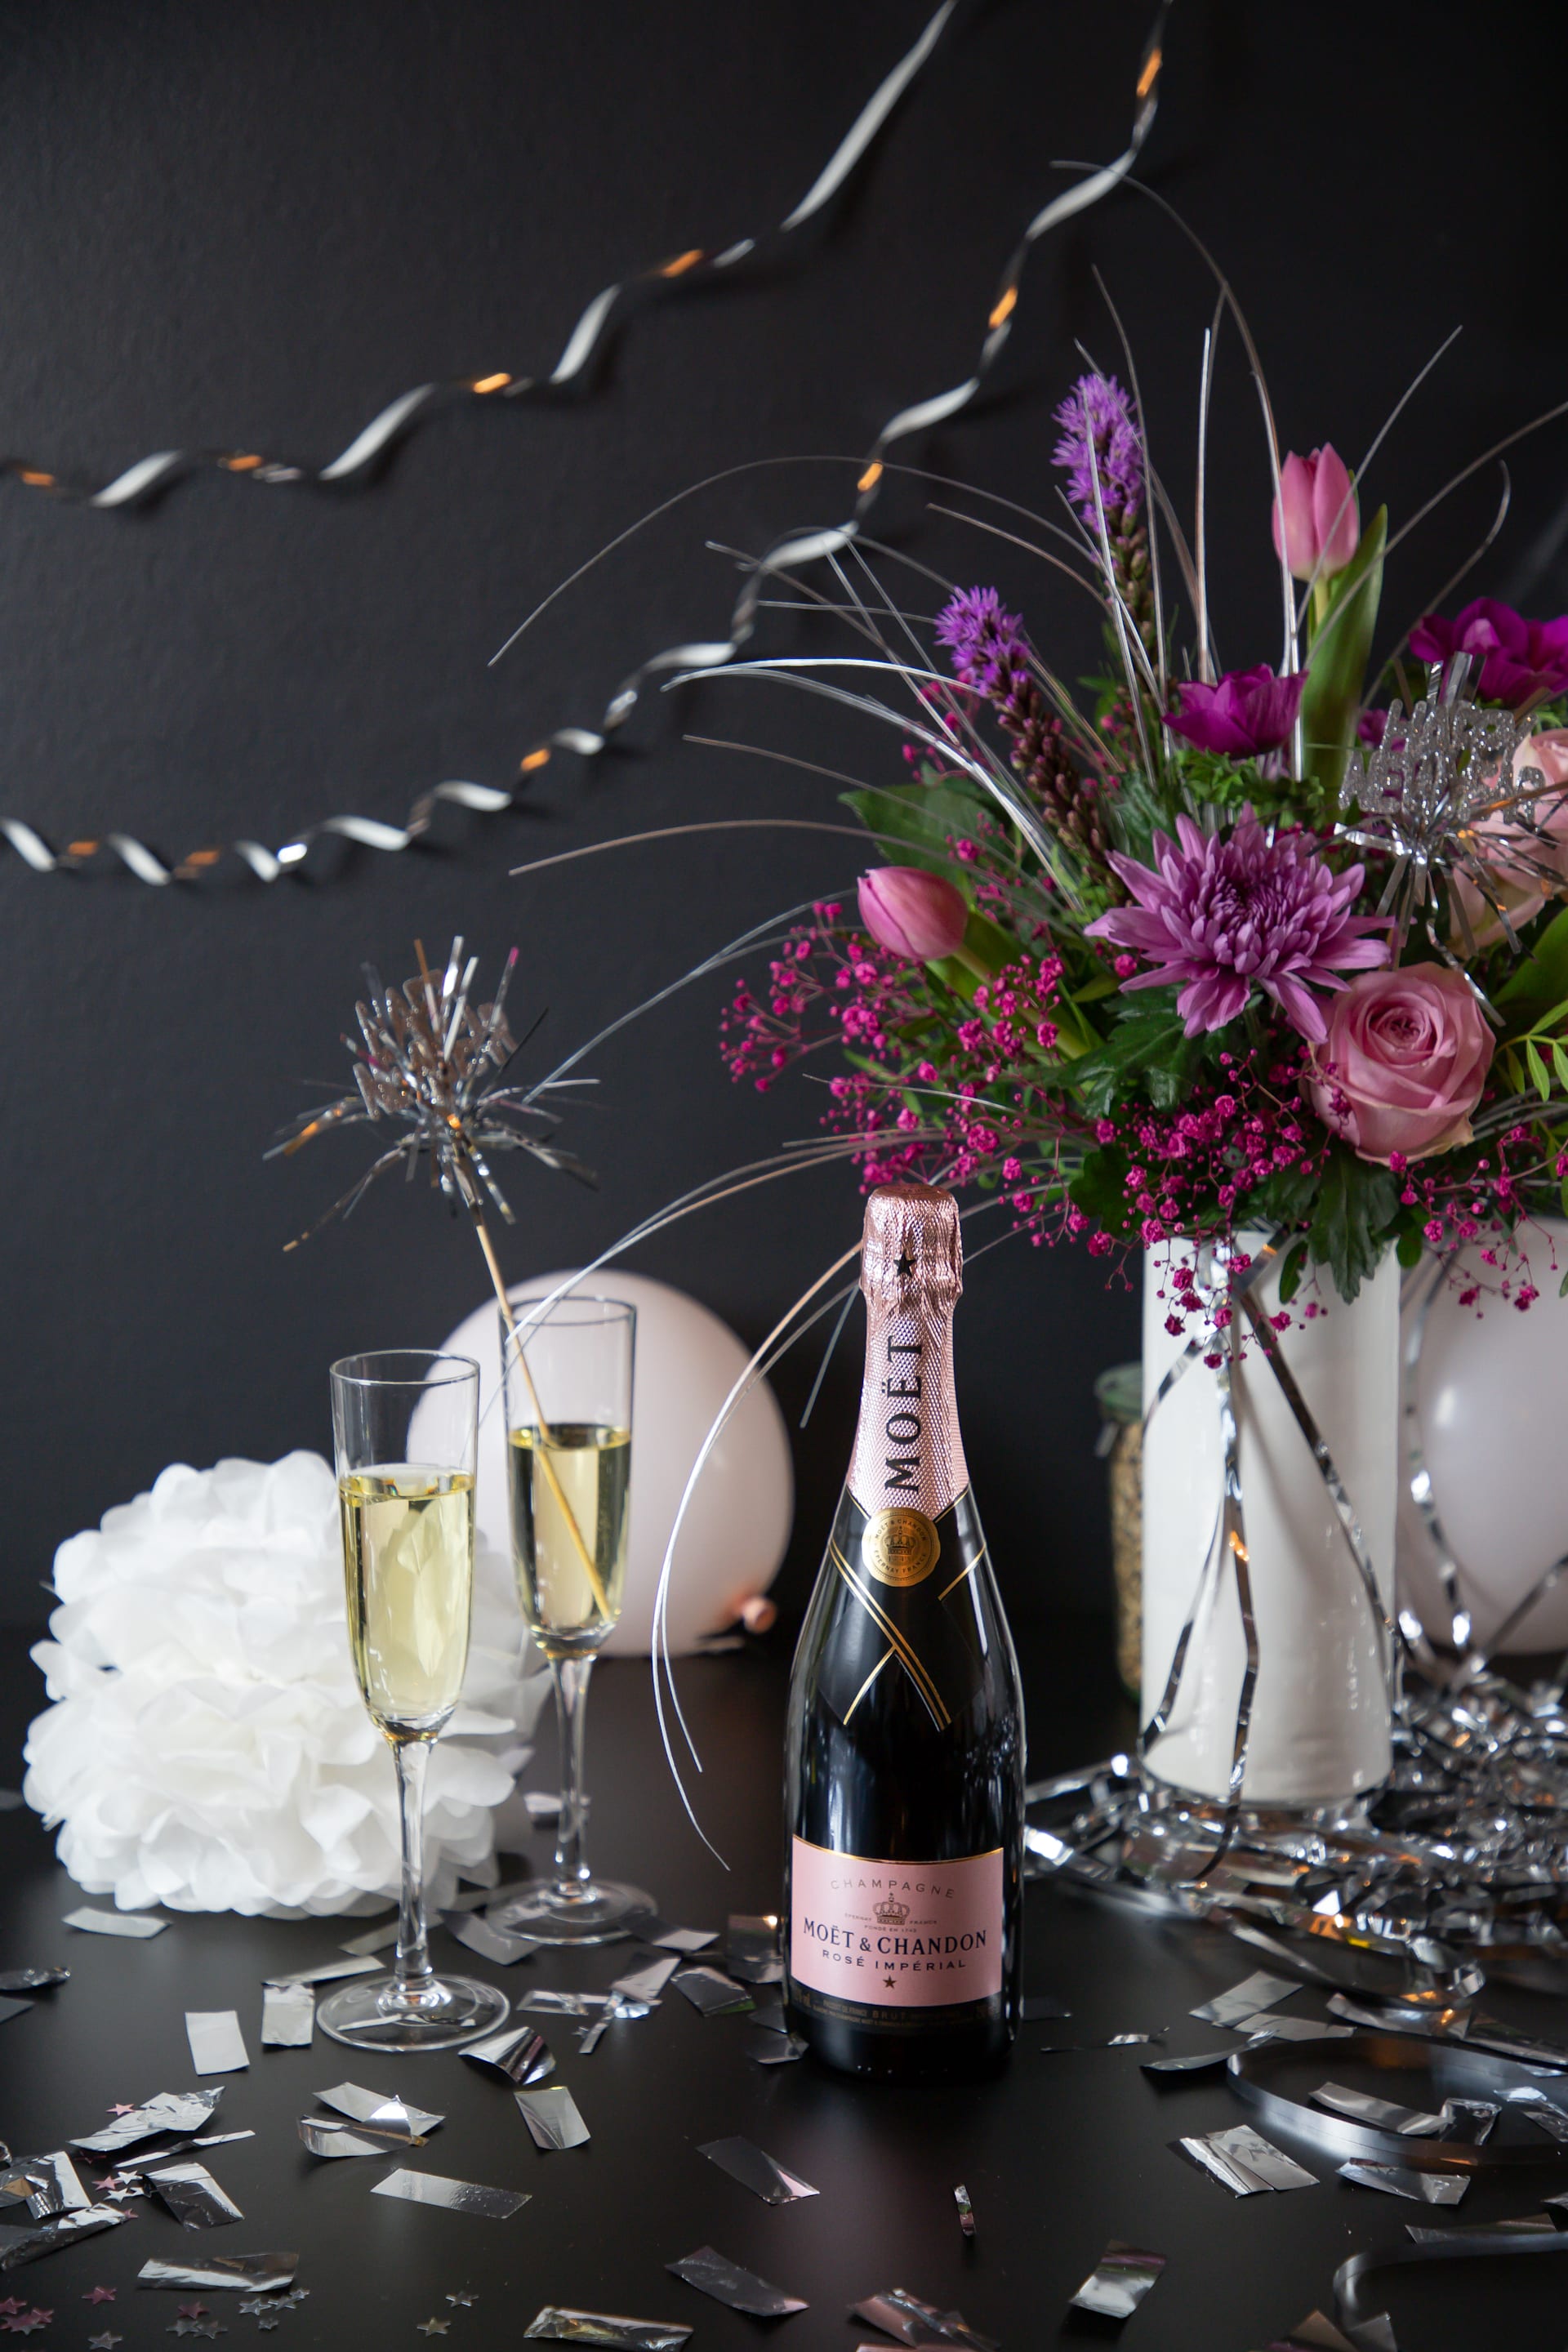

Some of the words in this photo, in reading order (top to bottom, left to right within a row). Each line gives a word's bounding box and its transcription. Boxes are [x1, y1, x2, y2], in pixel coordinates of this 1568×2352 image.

[882, 1334, 922, 1493] MOËT
[830, 1878, 955, 1899] CHAMPAGNE
[804, 1916, 855, 1949] MOËT
[859, 1937, 872, 1953] &
[877, 1929, 987, 1956] CHANDON
[822, 1949, 865, 1967] ROSÉ
[875, 1960, 967, 1971] IMPÉRIAL
